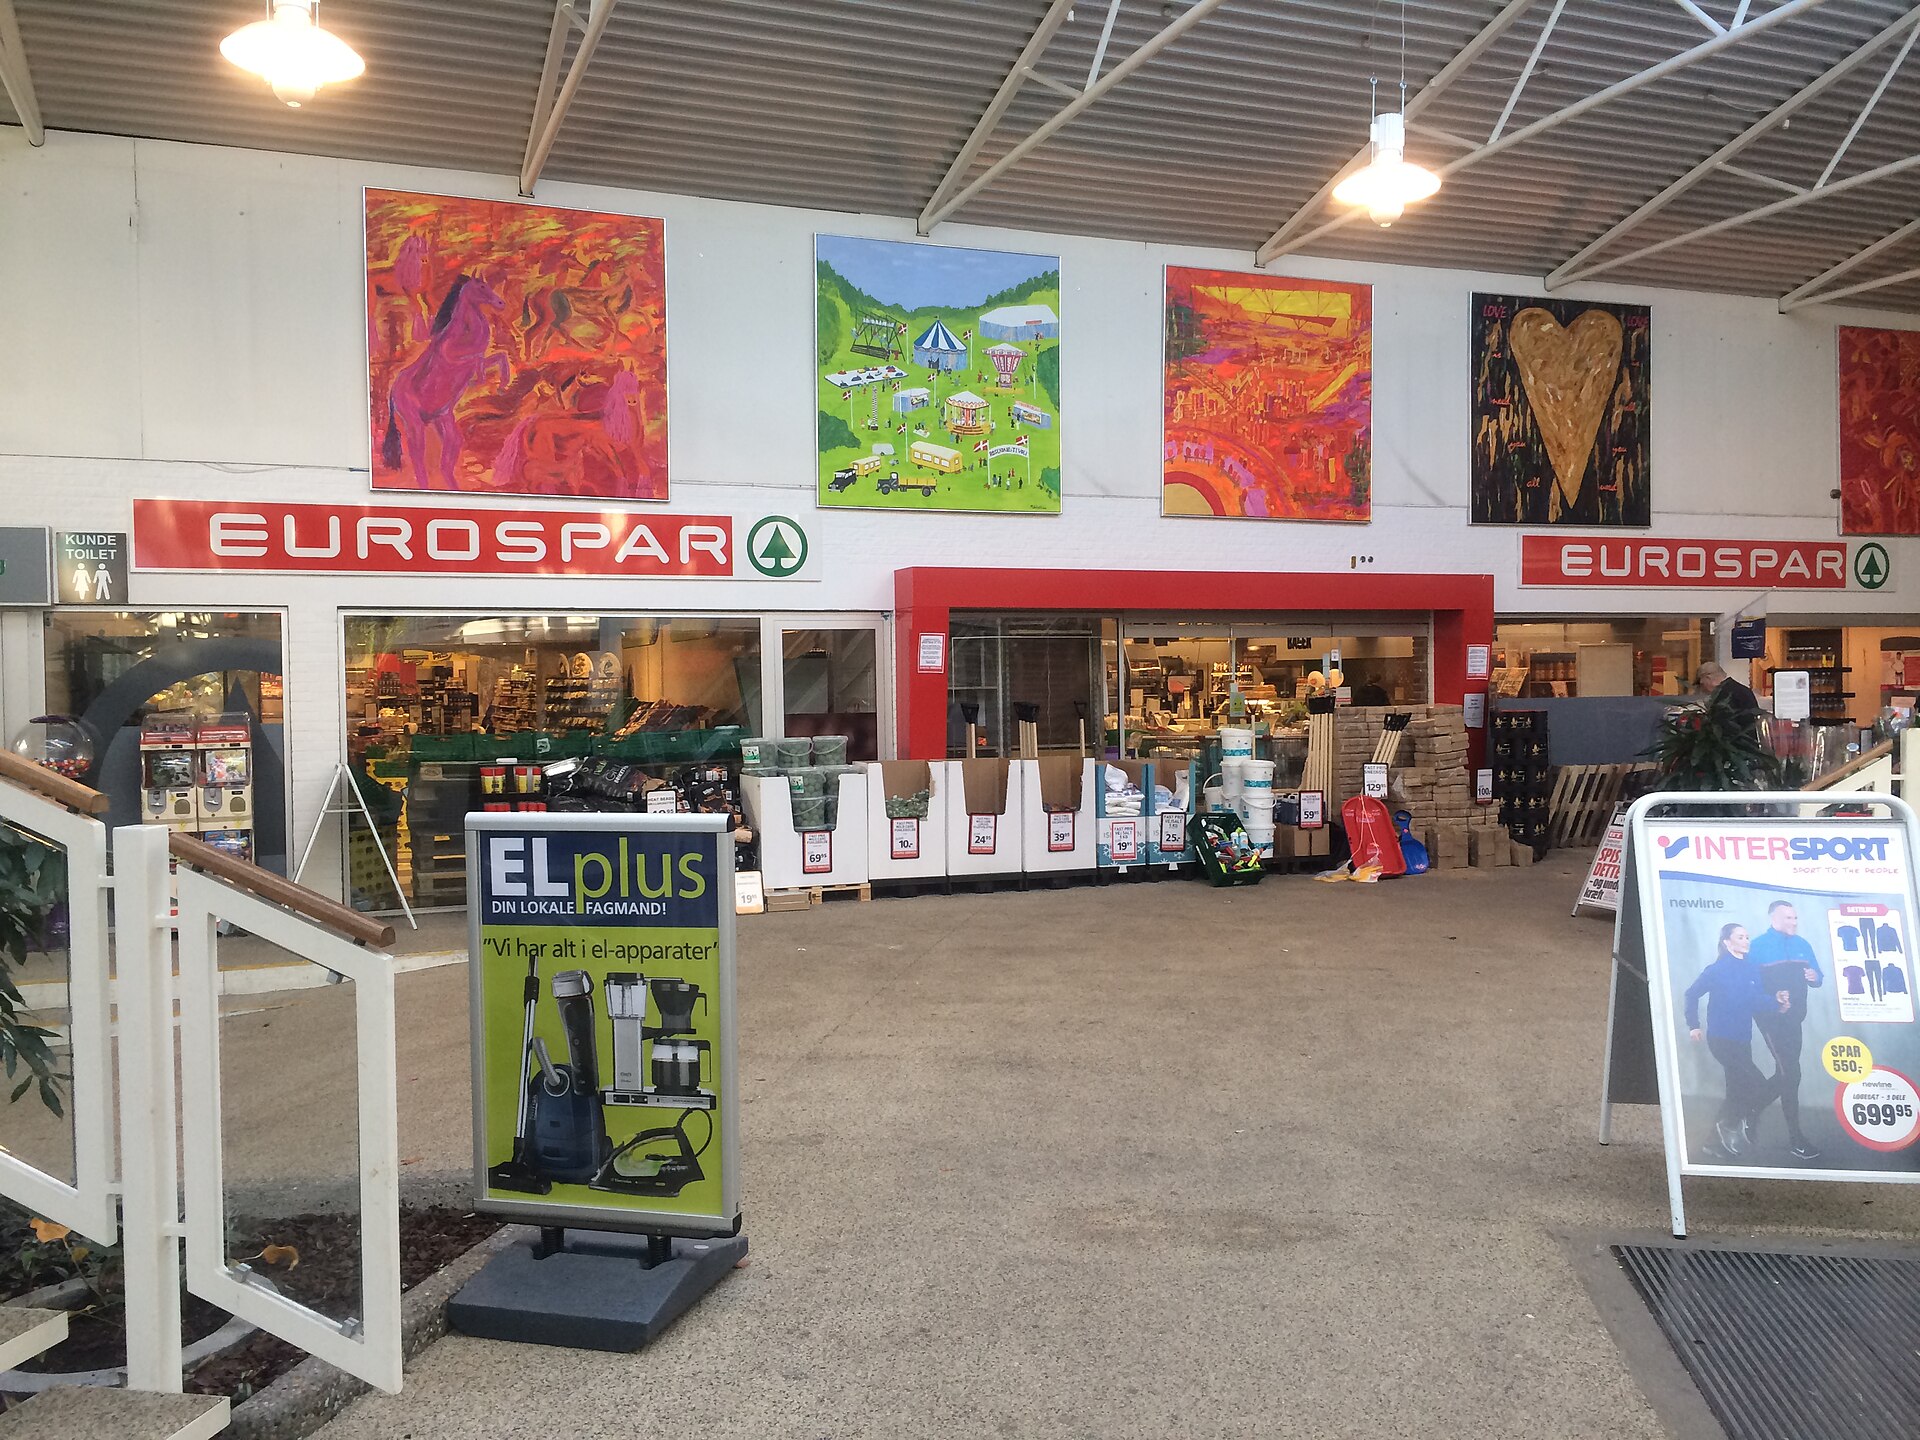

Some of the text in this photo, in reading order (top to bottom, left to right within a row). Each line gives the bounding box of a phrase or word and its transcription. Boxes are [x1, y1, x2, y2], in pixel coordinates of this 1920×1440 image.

[1482, 304, 1508, 318] LOVE
[65, 534, 117, 547] KUNDE
[208, 511, 729, 565] EUROSPAR
[65, 549, 117, 561] TOILET
[1561, 543, 1844, 580] EUROSPAR
[1694, 836, 1890, 861] INTERSPORT
[492, 901, 667, 916] DIN LOKALE FAGMAND!
[1669, 897, 1724, 909] newline
[516, 938, 547, 957] har
[552, 939, 577, 958] alt
[581, 939, 586, 958] i
[1831, 1045, 1861, 1058] SPAR
